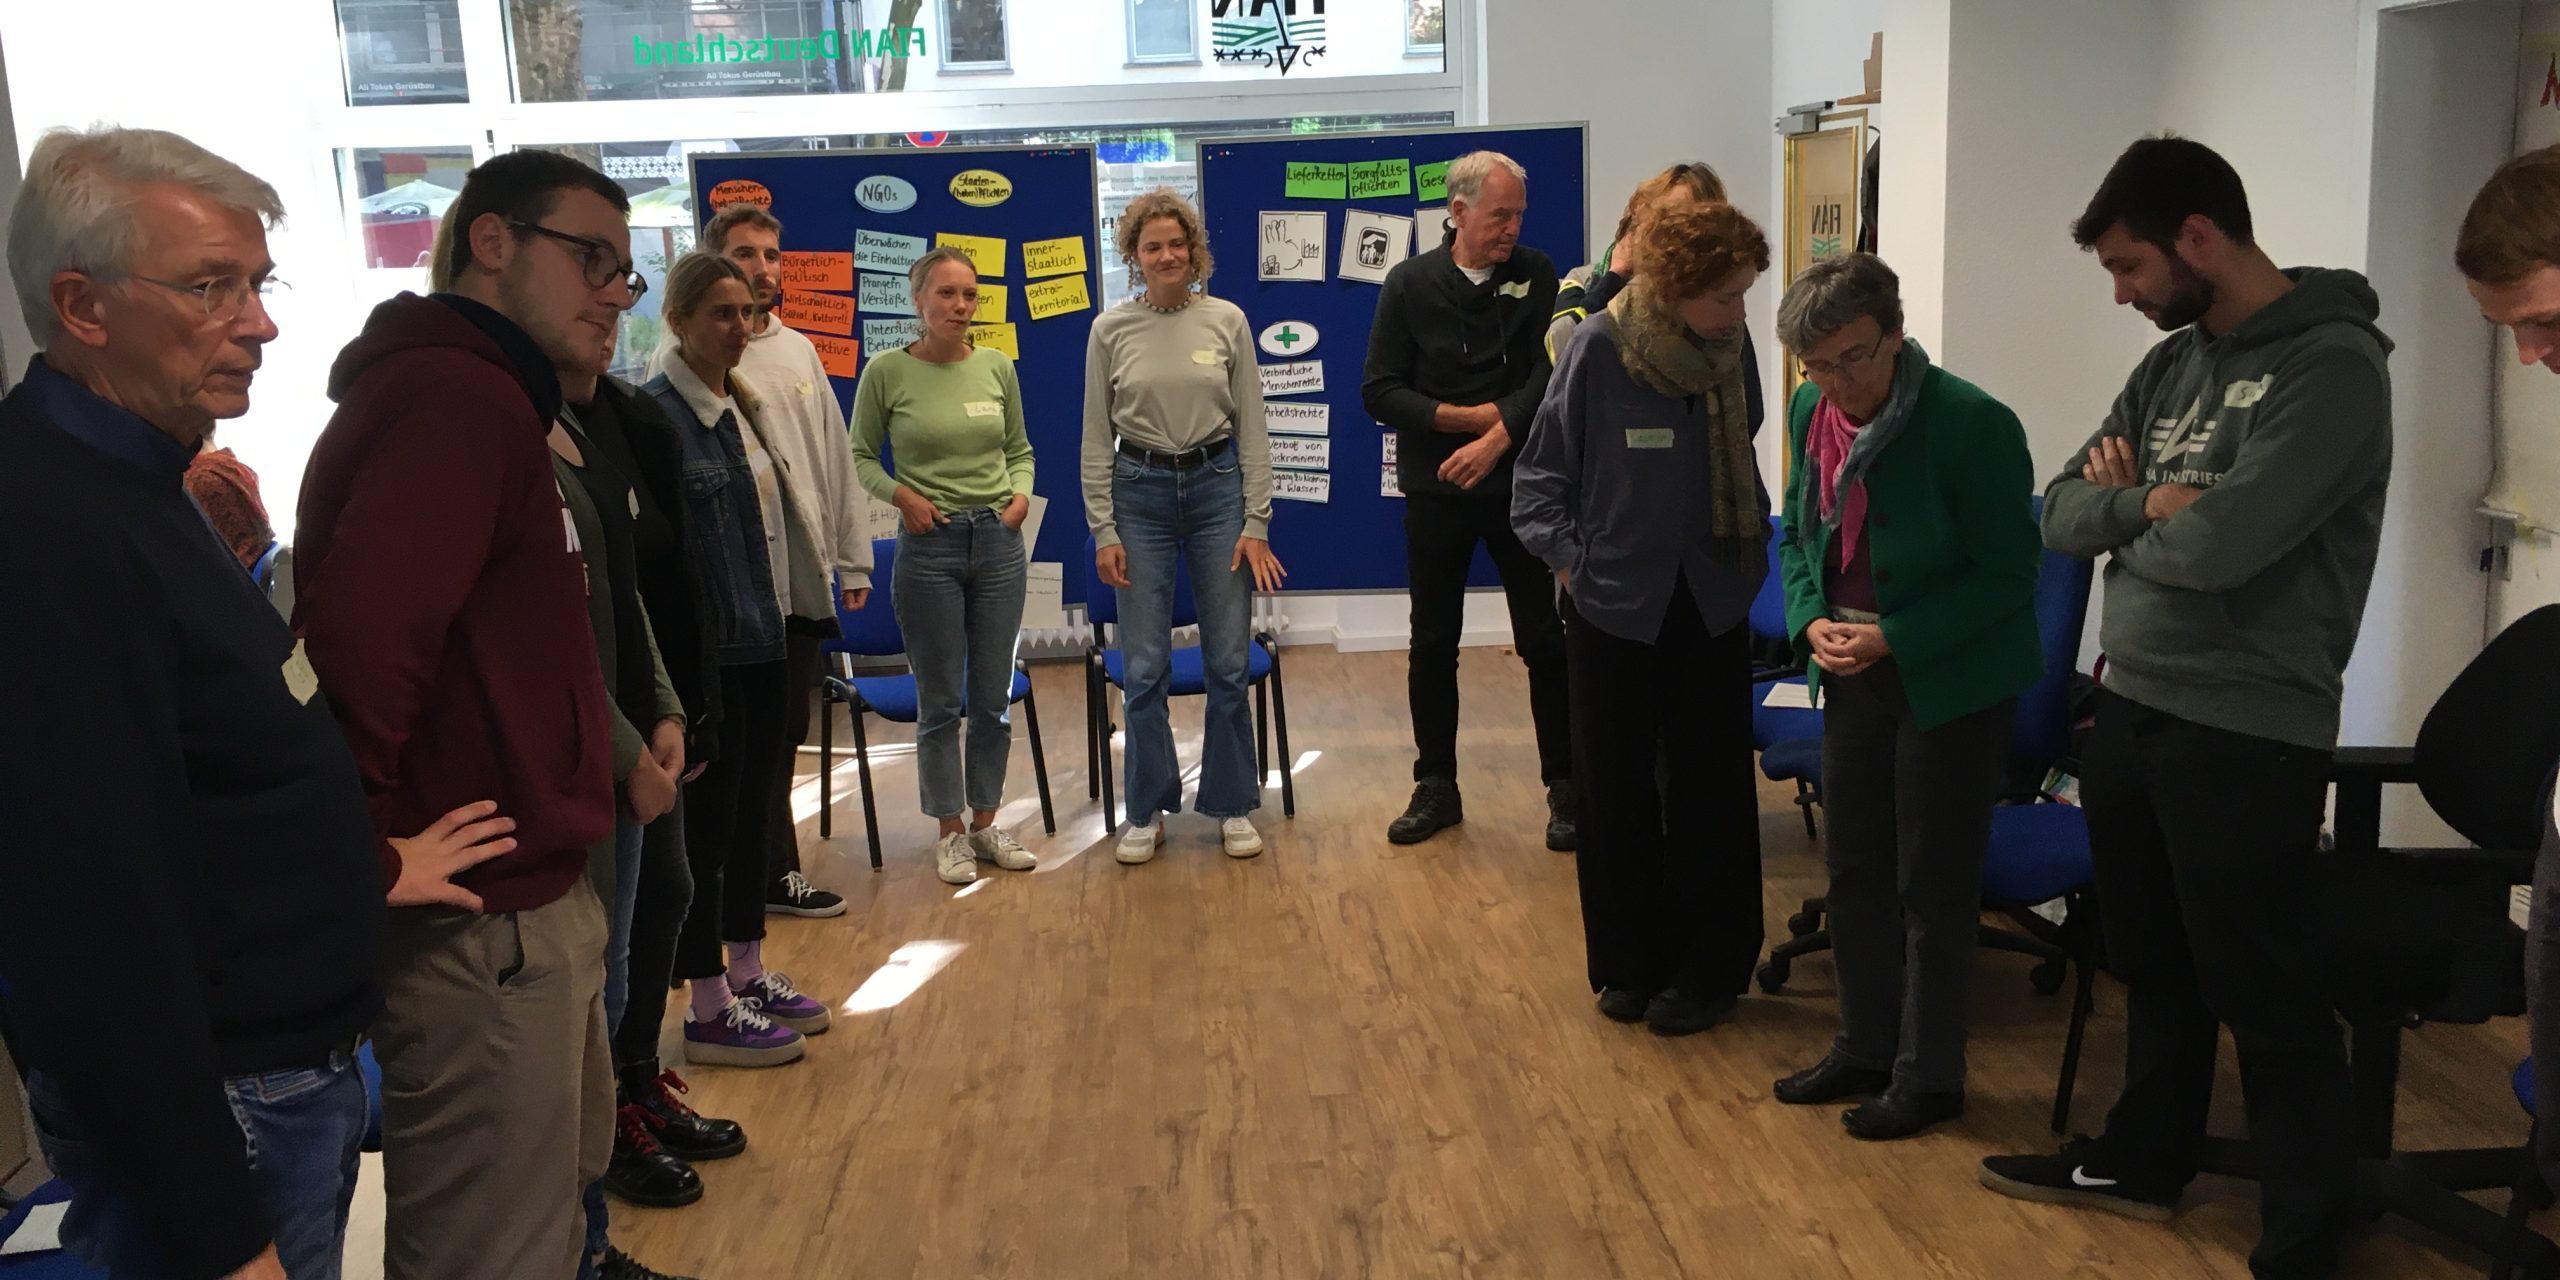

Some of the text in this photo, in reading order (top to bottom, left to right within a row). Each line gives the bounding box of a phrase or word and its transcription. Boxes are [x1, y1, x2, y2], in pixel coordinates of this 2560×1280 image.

[1352, 179, 1400, 197] pflichten
[1420, 171, 1447, 189] Gese
[862, 184, 898, 204] NGOs
[1025, 243, 1063, 257] inner-
[854, 250, 916, 267] die Einhaltun
[1027, 254, 1076, 272] staatlich
[783, 268, 829, 283] Politisch
[862, 276, 902, 296] Prangern
[1028, 284, 1064, 300] extra-
[862, 292, 908, 308] Verstöße
[1032, 290, 1086, 316] territorial
[1264, 404, 1325, 419] Arbeitsrechte
[1305, 443, 1323, 451] von
[1271, 473, 1294, 487] ugang
[1286, 484, 1320, 494] Wasser
